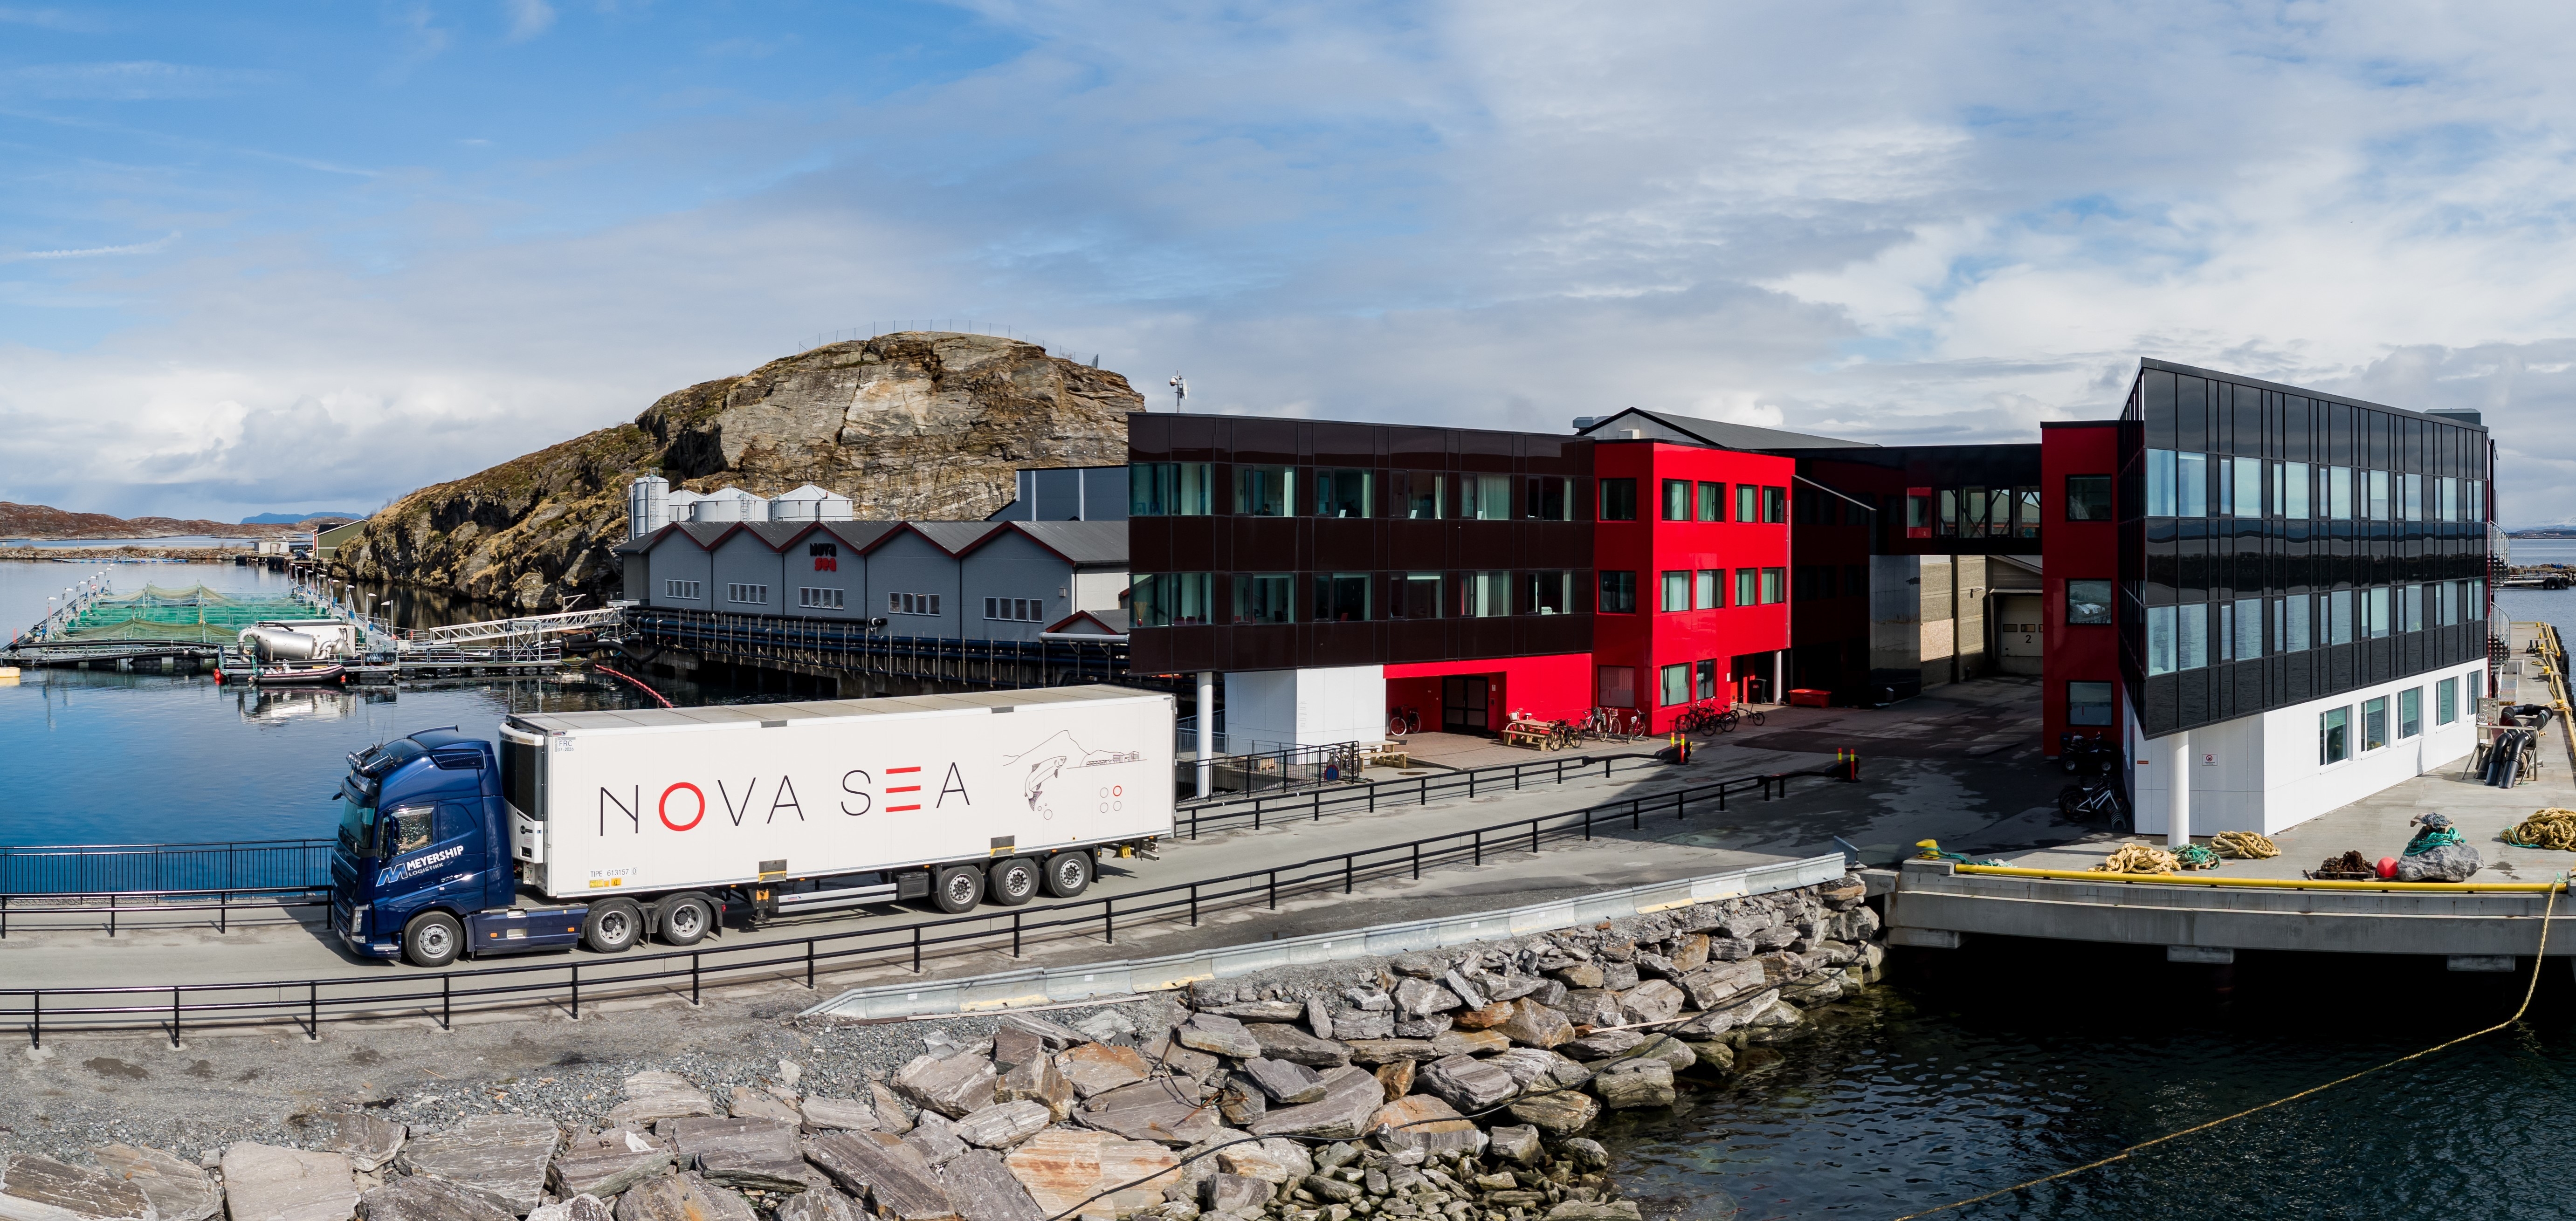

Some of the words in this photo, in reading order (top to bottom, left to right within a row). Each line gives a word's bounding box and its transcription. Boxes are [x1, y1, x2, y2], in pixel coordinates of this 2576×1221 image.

[2025, 634, 2032, 643] 2
[600, 775, 804, 836] NOVA
[841, 762, 970, 816] SEA
[406, 845, 464, 871] MEYERSHIP
[408, 863, 444, 877] LOGISTIKK
